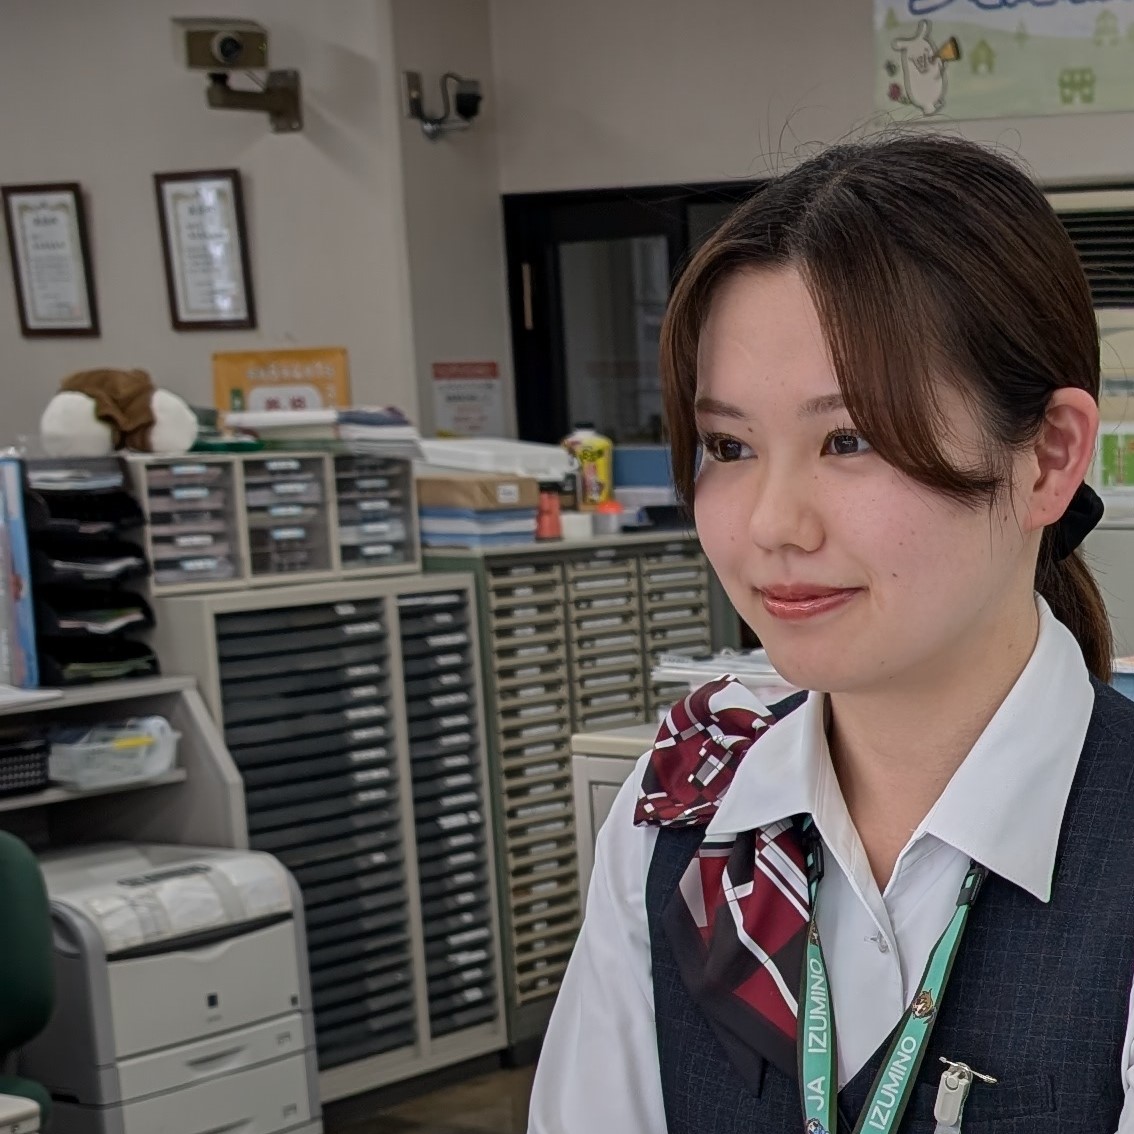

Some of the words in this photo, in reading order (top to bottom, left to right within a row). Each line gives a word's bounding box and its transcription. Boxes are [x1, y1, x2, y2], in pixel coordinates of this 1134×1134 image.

[807, 958, 828, 1053] IZUMINO
[807, 1075, 826, 1111] JA
[868, 1036, 917, 1131] IZUMINO
